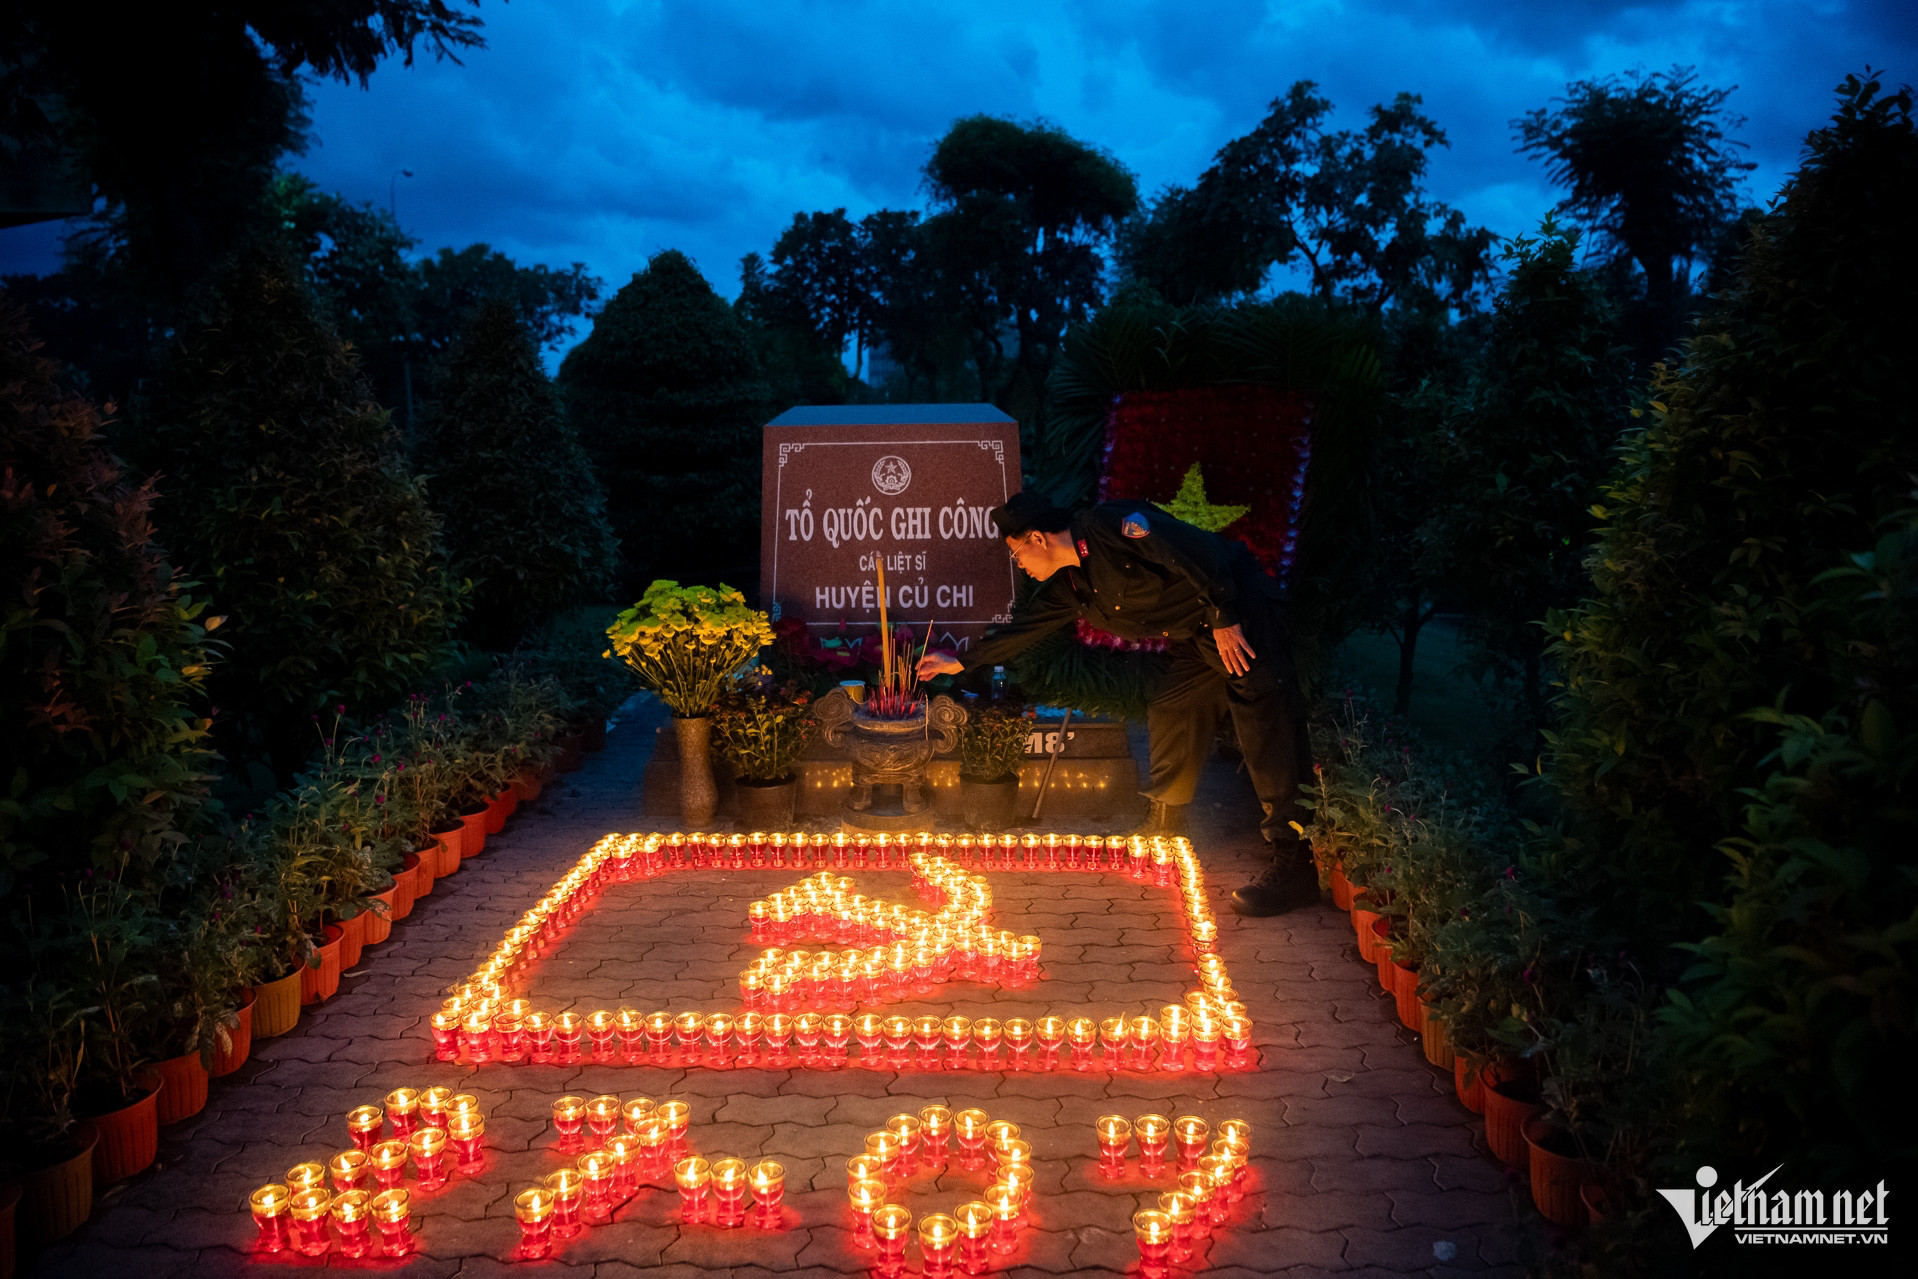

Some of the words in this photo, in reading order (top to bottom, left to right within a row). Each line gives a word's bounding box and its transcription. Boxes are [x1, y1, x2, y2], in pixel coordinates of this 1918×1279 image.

[785, 488, 815, 541] TỔ
[822, 496, 884, 548] QUỐC
[890, 507, 932, 540] GHI
[938, 497, 1000, 540] CÔNG
[859, 551, 883, 571] CÁ
[887, 550, 912, 574] LIỆT
[915, 550, 927, 571] SĨ
[815, 579, 891, 613] HUYỆN
[898, 577, 929, 608] CỦ
[936, 585, 974, 608] CHI
